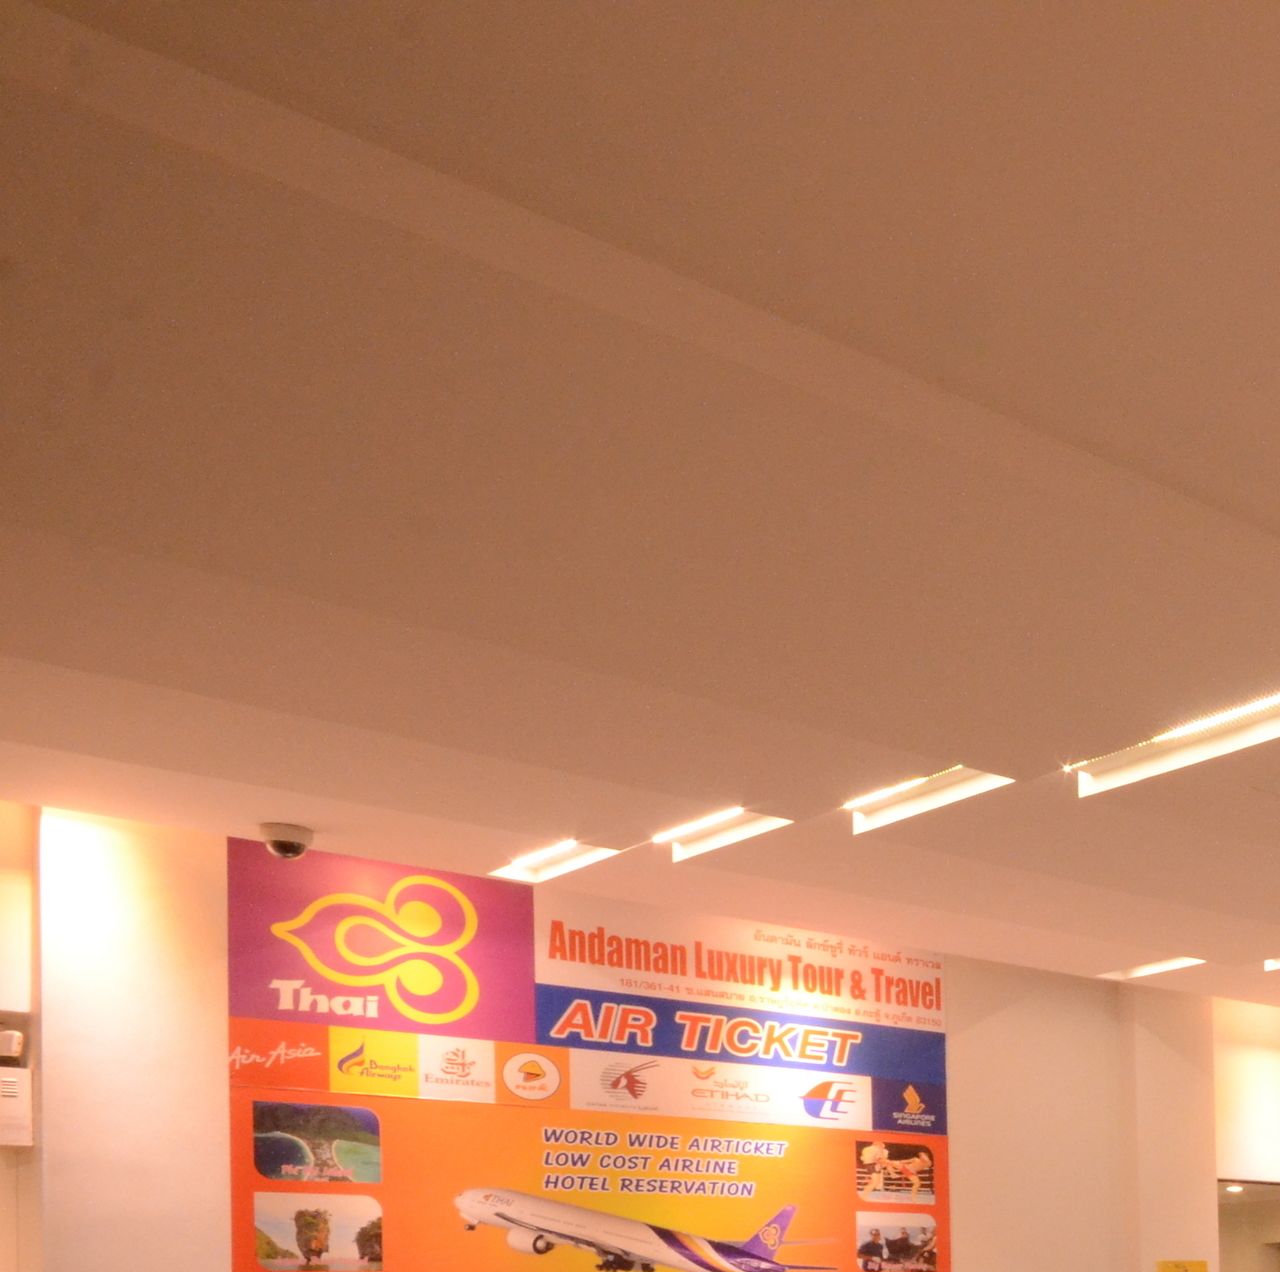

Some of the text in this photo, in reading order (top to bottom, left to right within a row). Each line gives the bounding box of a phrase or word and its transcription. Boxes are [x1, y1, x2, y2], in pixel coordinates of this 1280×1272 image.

[548, 920, 942, 1011] Andaman Luxury Tour & Travel
[268, 979, 379, 1018] Thai
[550, 999, 862, 1066] AIR TICKET
[229, 1041, 322, 1069] Air Asia
[370, 1060, 415, 1073] Bangkok
[424, 1074, 491, 1088] Emirates
[691, 1088, 770, 1103] ETIHAD
[892, 1111, 936, 1121] SINGAPORE
[897, 1119, 932, 1127] AIRLINES
[543, 1128, 786, 1156] WORLD WIDE AIRTICKET
[544, 1152, 737, 1174] LOW COST AIRLINE
[544, 1175, 754, 1196] HOTEL RESERVATION
